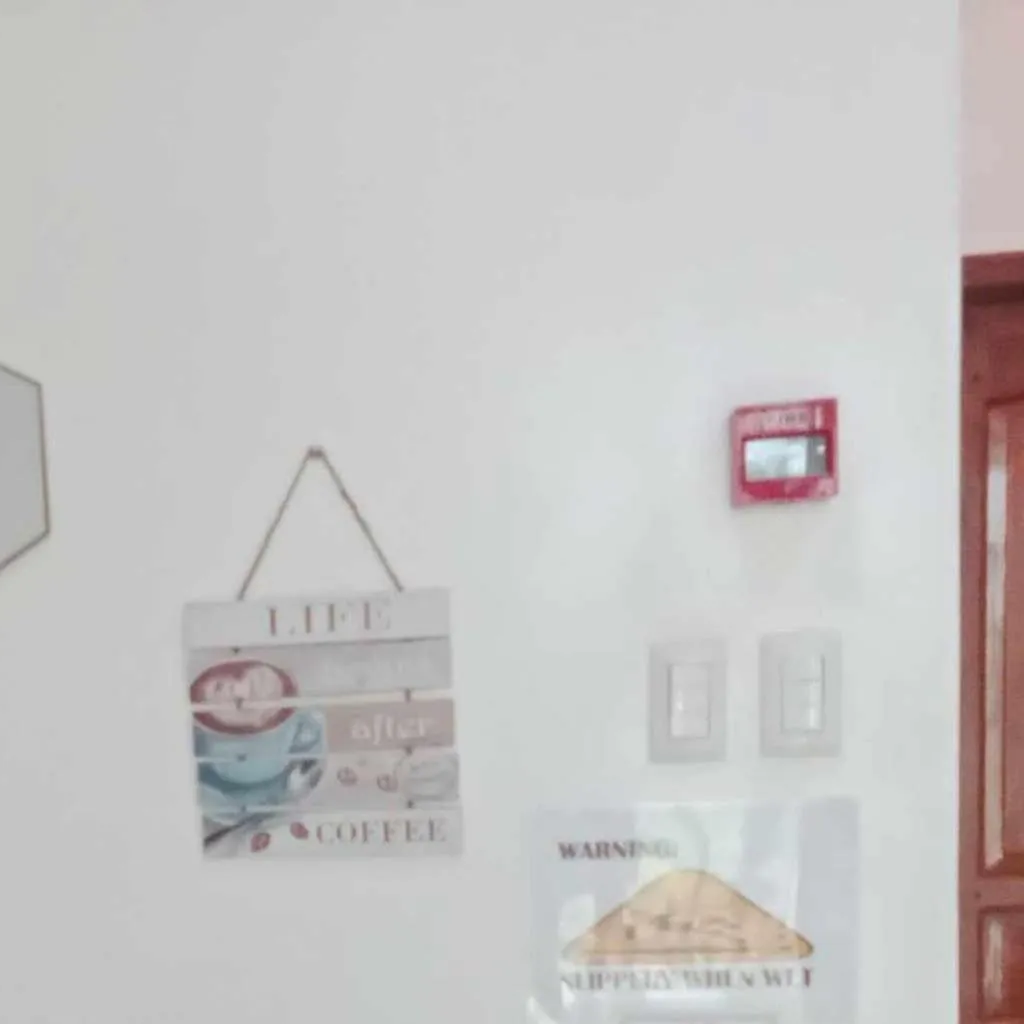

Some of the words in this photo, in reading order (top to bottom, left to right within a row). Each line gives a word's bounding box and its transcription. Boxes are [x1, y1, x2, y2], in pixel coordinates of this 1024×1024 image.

[267, 600, 393, 636] LIFE
[316, 818, 447, 845] COFFEE
[682, 968, 756, 990] WHEN
[761, 965, 814, 988] WET
